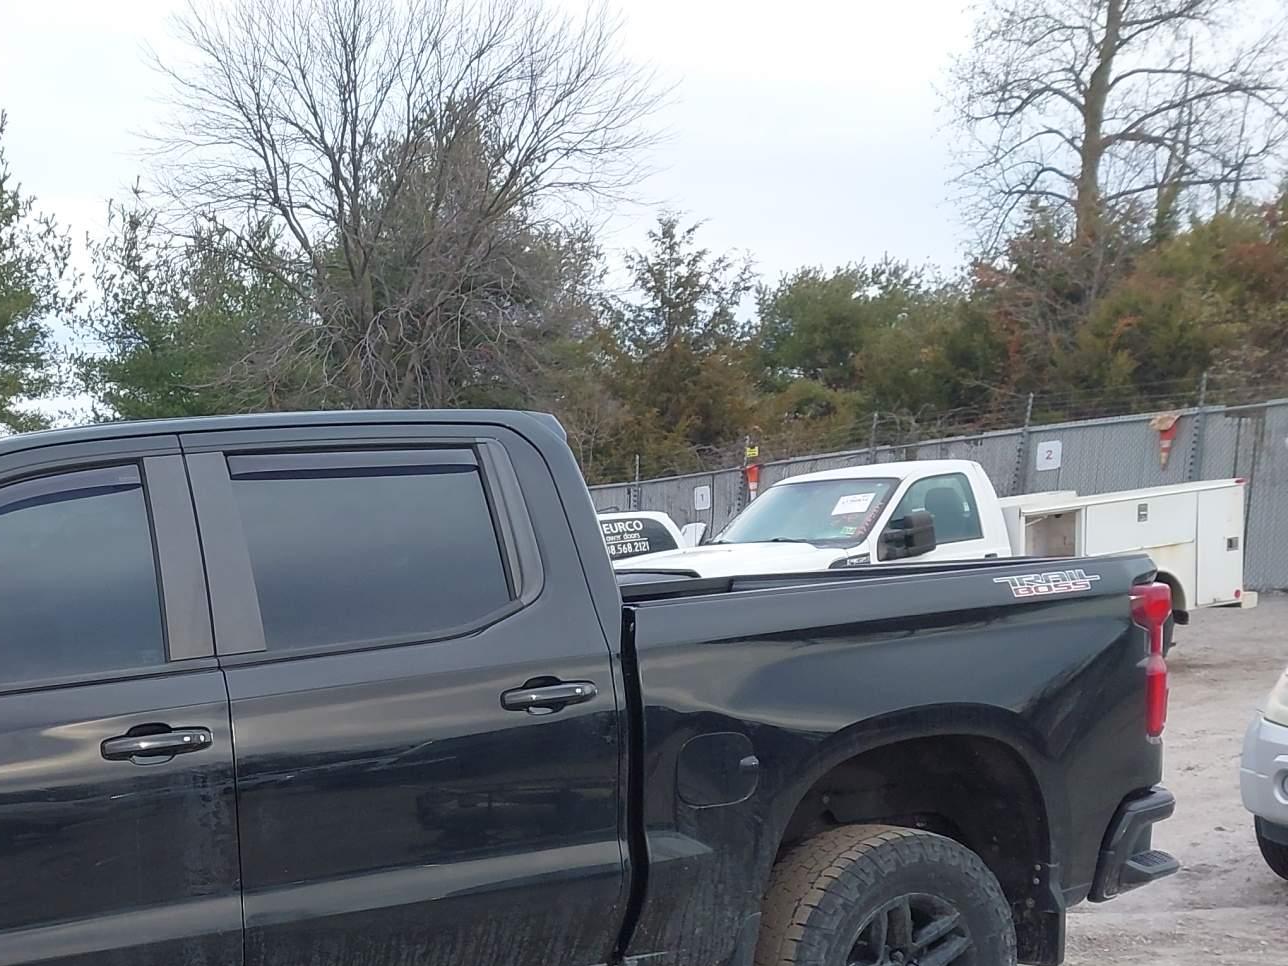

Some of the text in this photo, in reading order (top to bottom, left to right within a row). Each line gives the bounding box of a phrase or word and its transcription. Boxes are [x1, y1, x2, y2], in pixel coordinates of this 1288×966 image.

[1045, 449, 1053, 460] 2
[602, 520, 643, 534] EURCO
[993, 569, 1100, 587] TRAIL
[1011, 580, 1091, 598] BOSS
